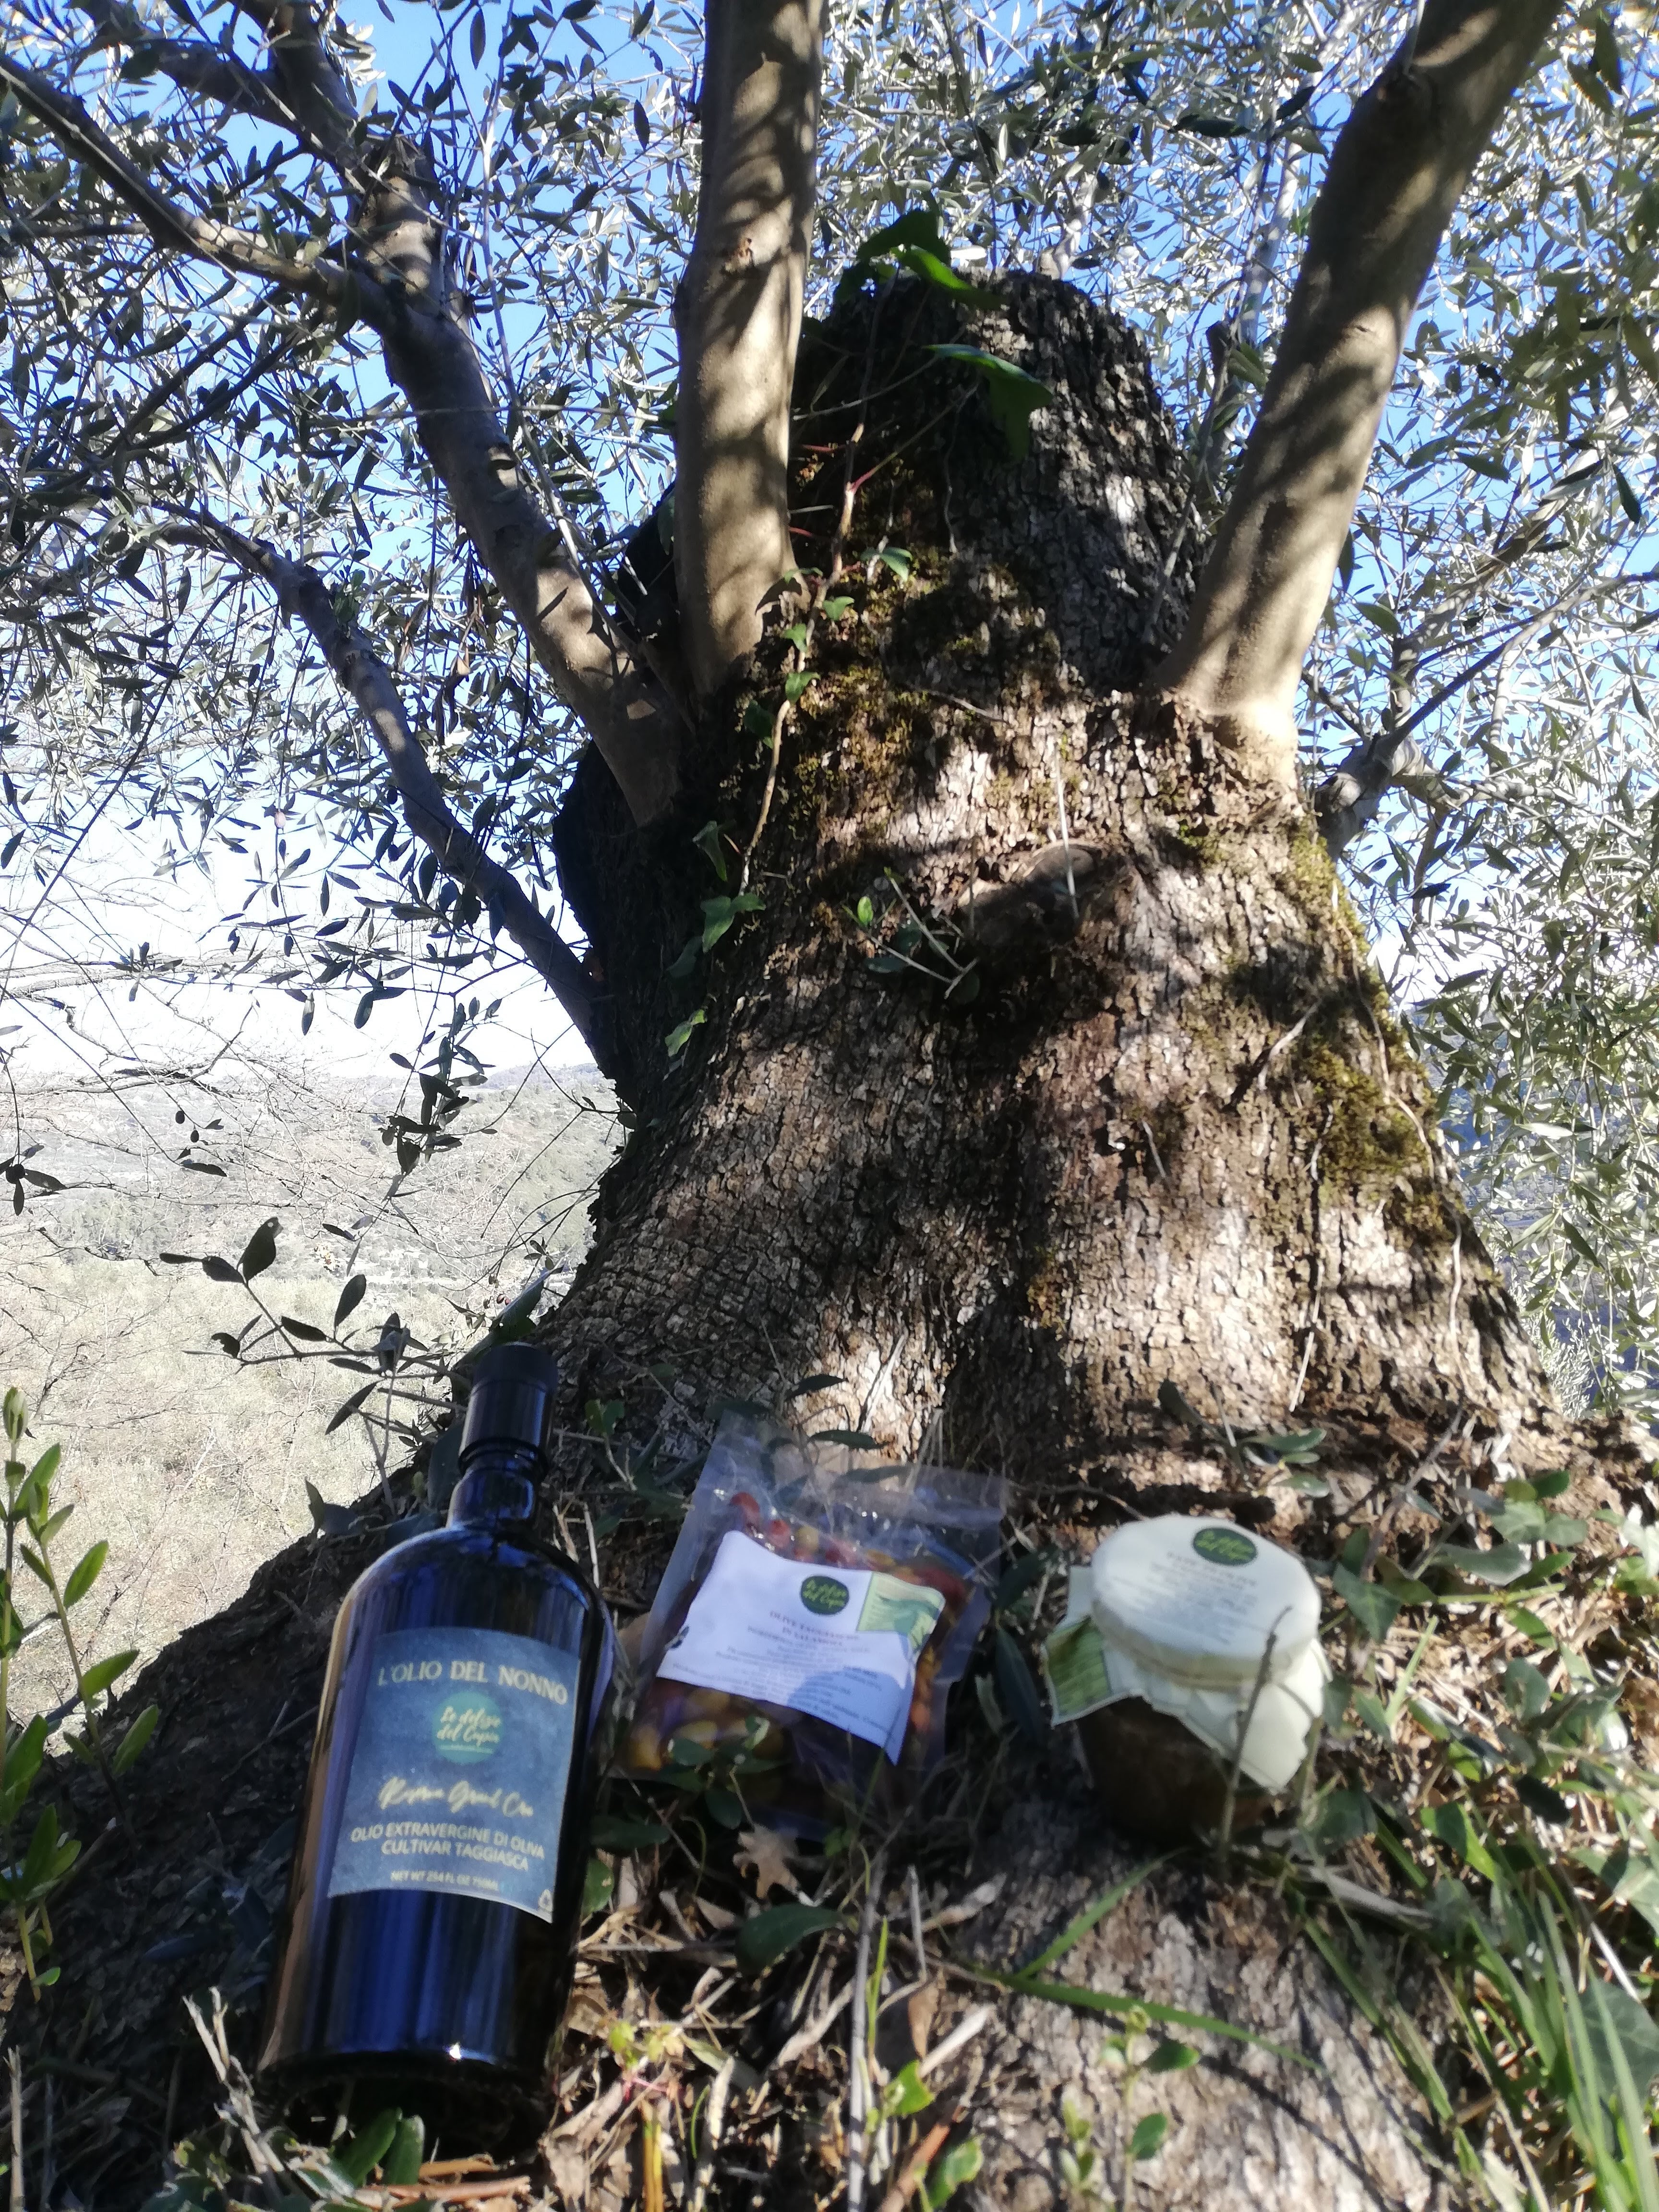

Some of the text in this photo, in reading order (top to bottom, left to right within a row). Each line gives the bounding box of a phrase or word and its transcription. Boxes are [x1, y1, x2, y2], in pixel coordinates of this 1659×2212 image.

[377, 1659, 568, 1705] L'OLIO DEL NONNO
[350, 1821, 545, 1860] OLIO EXTRAVERGINE DI OLIVA
[381, 1839, 529, 1871] CULTIVAR TAGGIASCA
[390, 1870, 408, 1882] NET
